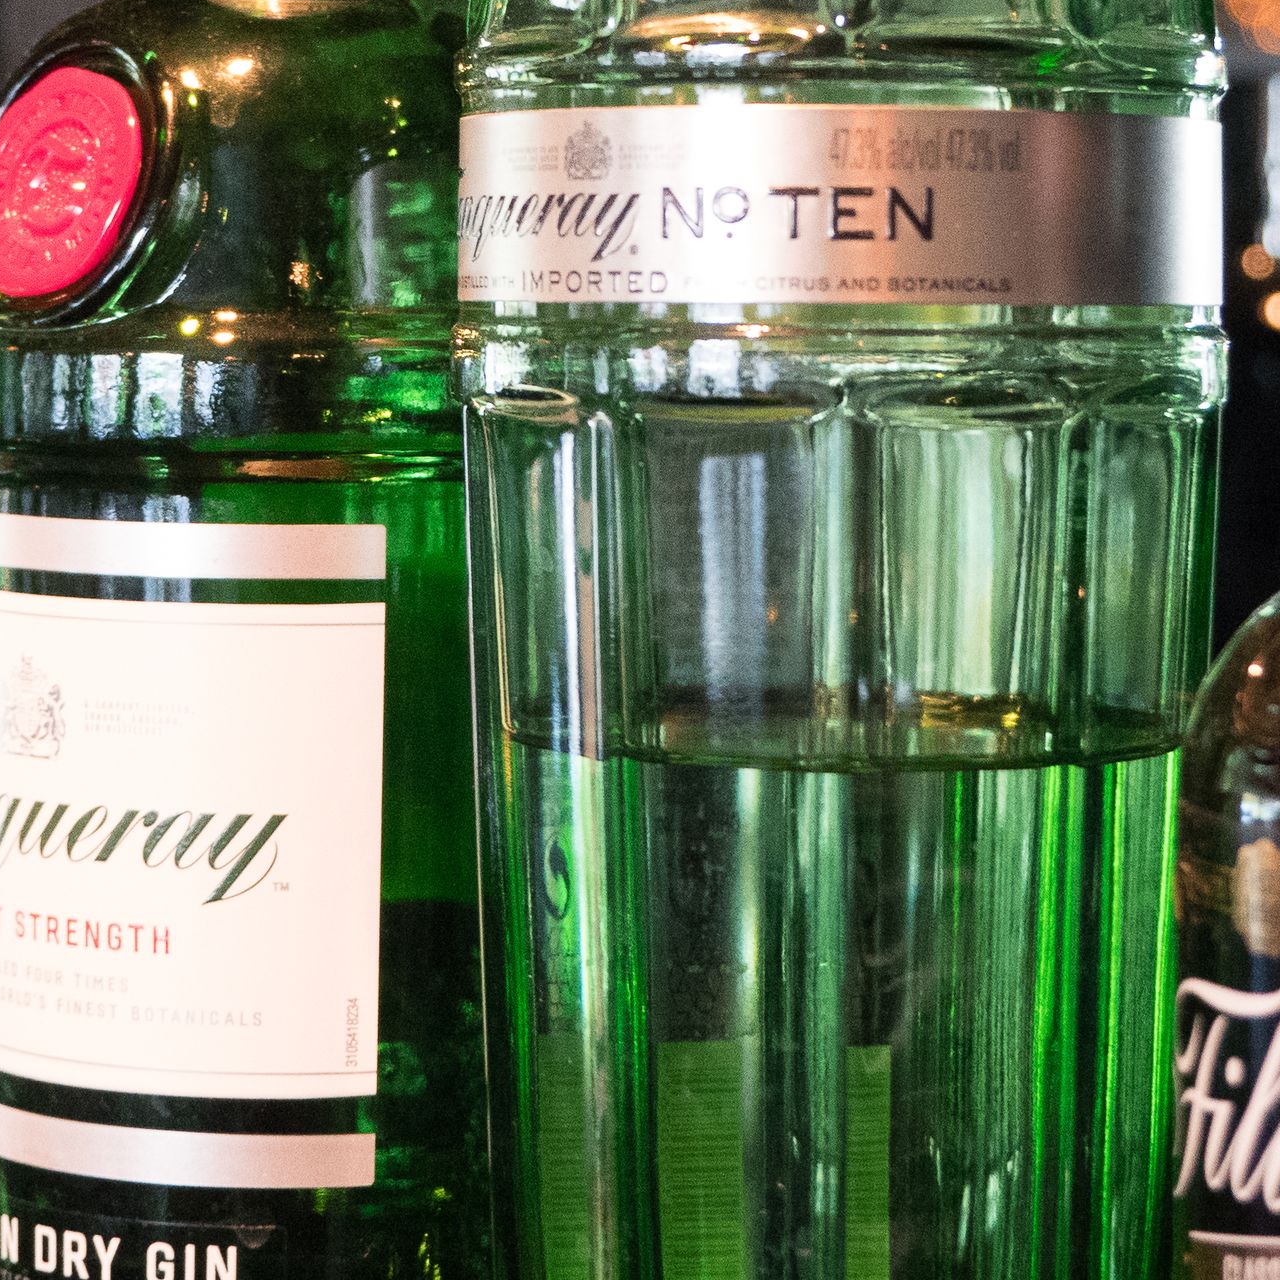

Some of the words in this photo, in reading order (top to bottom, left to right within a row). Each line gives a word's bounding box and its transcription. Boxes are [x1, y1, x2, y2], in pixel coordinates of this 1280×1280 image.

[769, 186, 934, 240] TEN
[522, 270, 669, 293] IMPORTED
[755, 276, 830, 293] CITRUS
[836, 276, 881, 293] AND
[888, 276, 1013, 295] BOTANICALS
[15, 909, 170, 955] STRENGTH
[74, 972, 129, 994] TIMES
[57, 996, 119, 1020] FINEST
[130, 1005, 263, 1027] BOTANICALS
[34, 1223, 121, 1280] DRY
[146, 1240, 238, 1280] GIN
